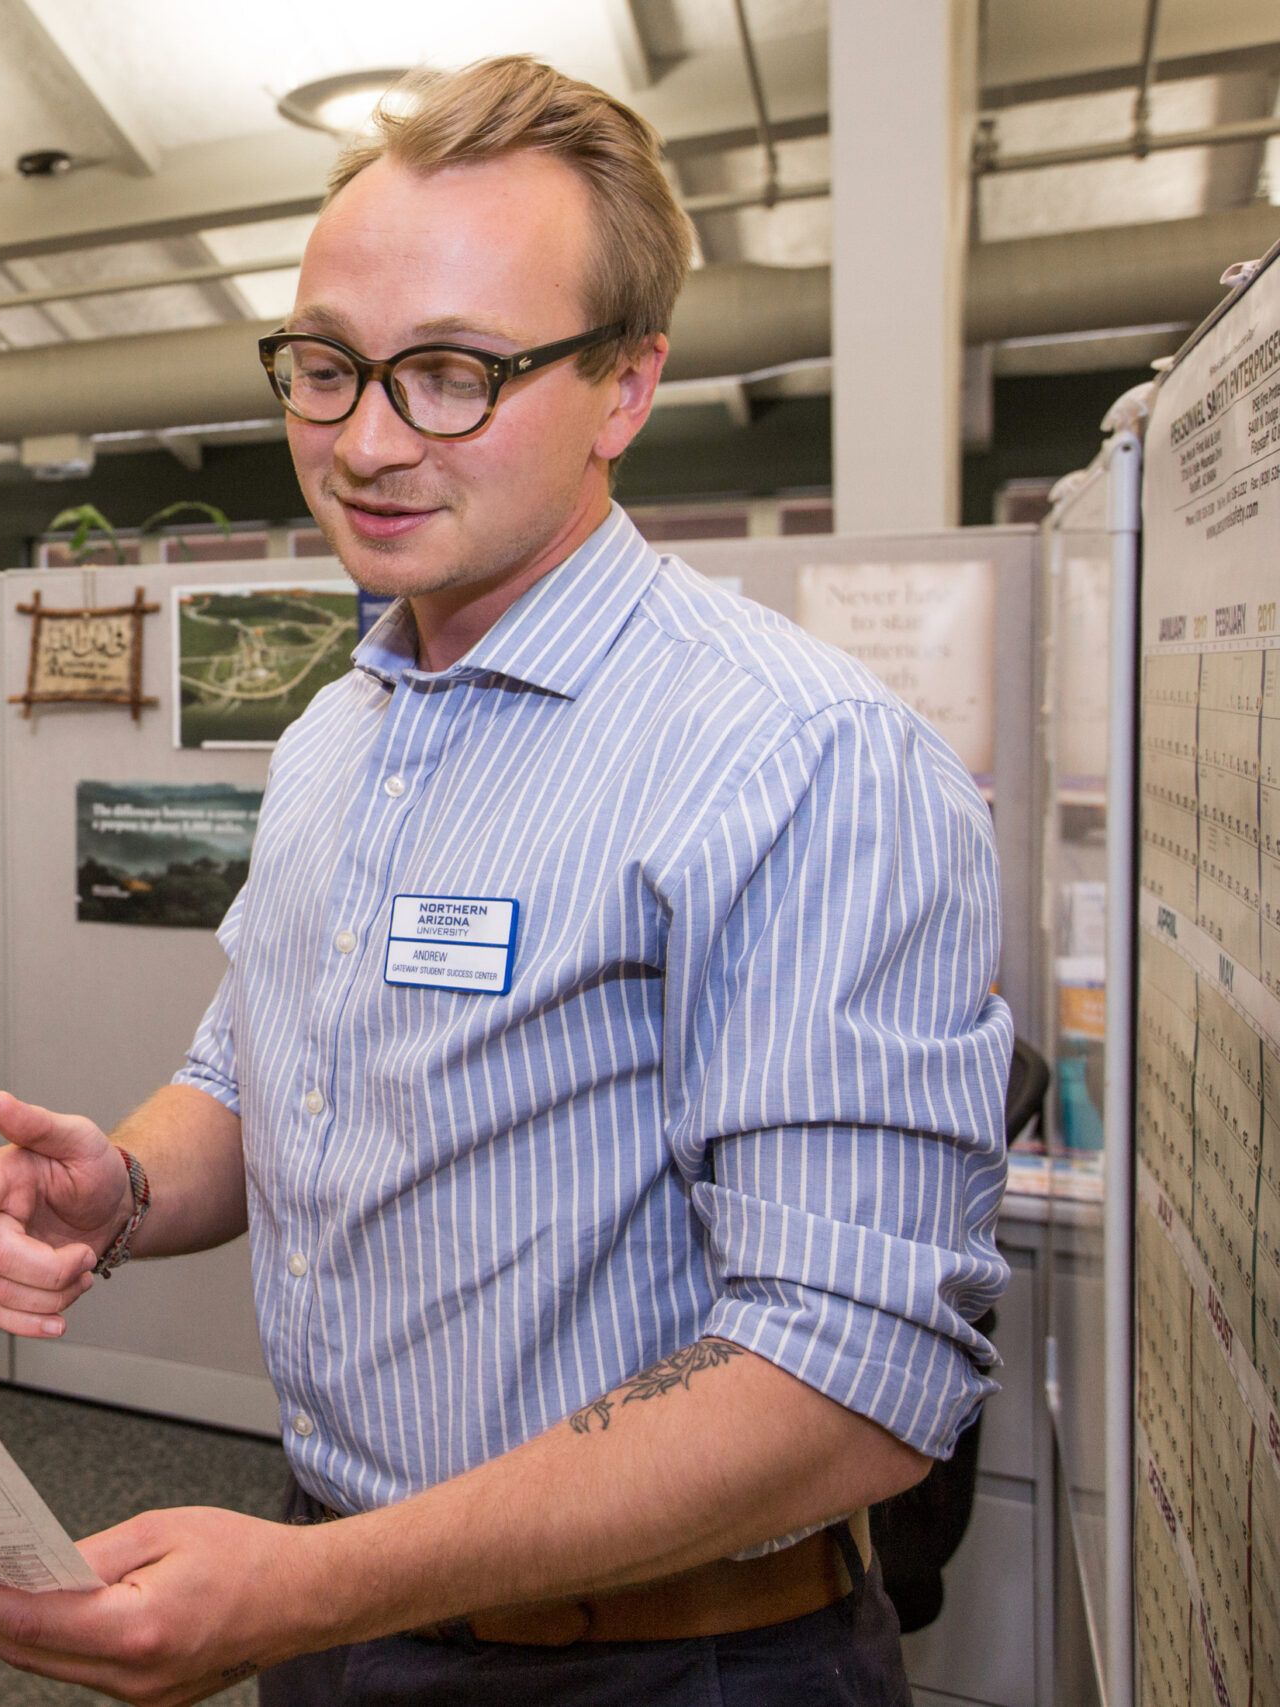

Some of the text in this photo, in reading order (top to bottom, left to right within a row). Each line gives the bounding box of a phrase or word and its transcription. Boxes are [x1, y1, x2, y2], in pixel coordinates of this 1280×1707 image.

[1230, 329, 1280, 399] ENTERPRISE
[1215, 602, 1248, 637] FEBRUARY
[1258, 601, 1277, 633] 2017
[419, 902, 488, 916] NORTHERN
[417, 914, 470, 927] ARIZONA
[416, 926, 469, 938] UNIVERSITY
[412, 949, 448, 963] ANDREW
[392, 963, 498, 981] GATEWAY STUDENT SUCCESS CENTER
[1218, 952, 1235, 993] MAY
[1207, 1284, 1234, 1358] AUGUST
